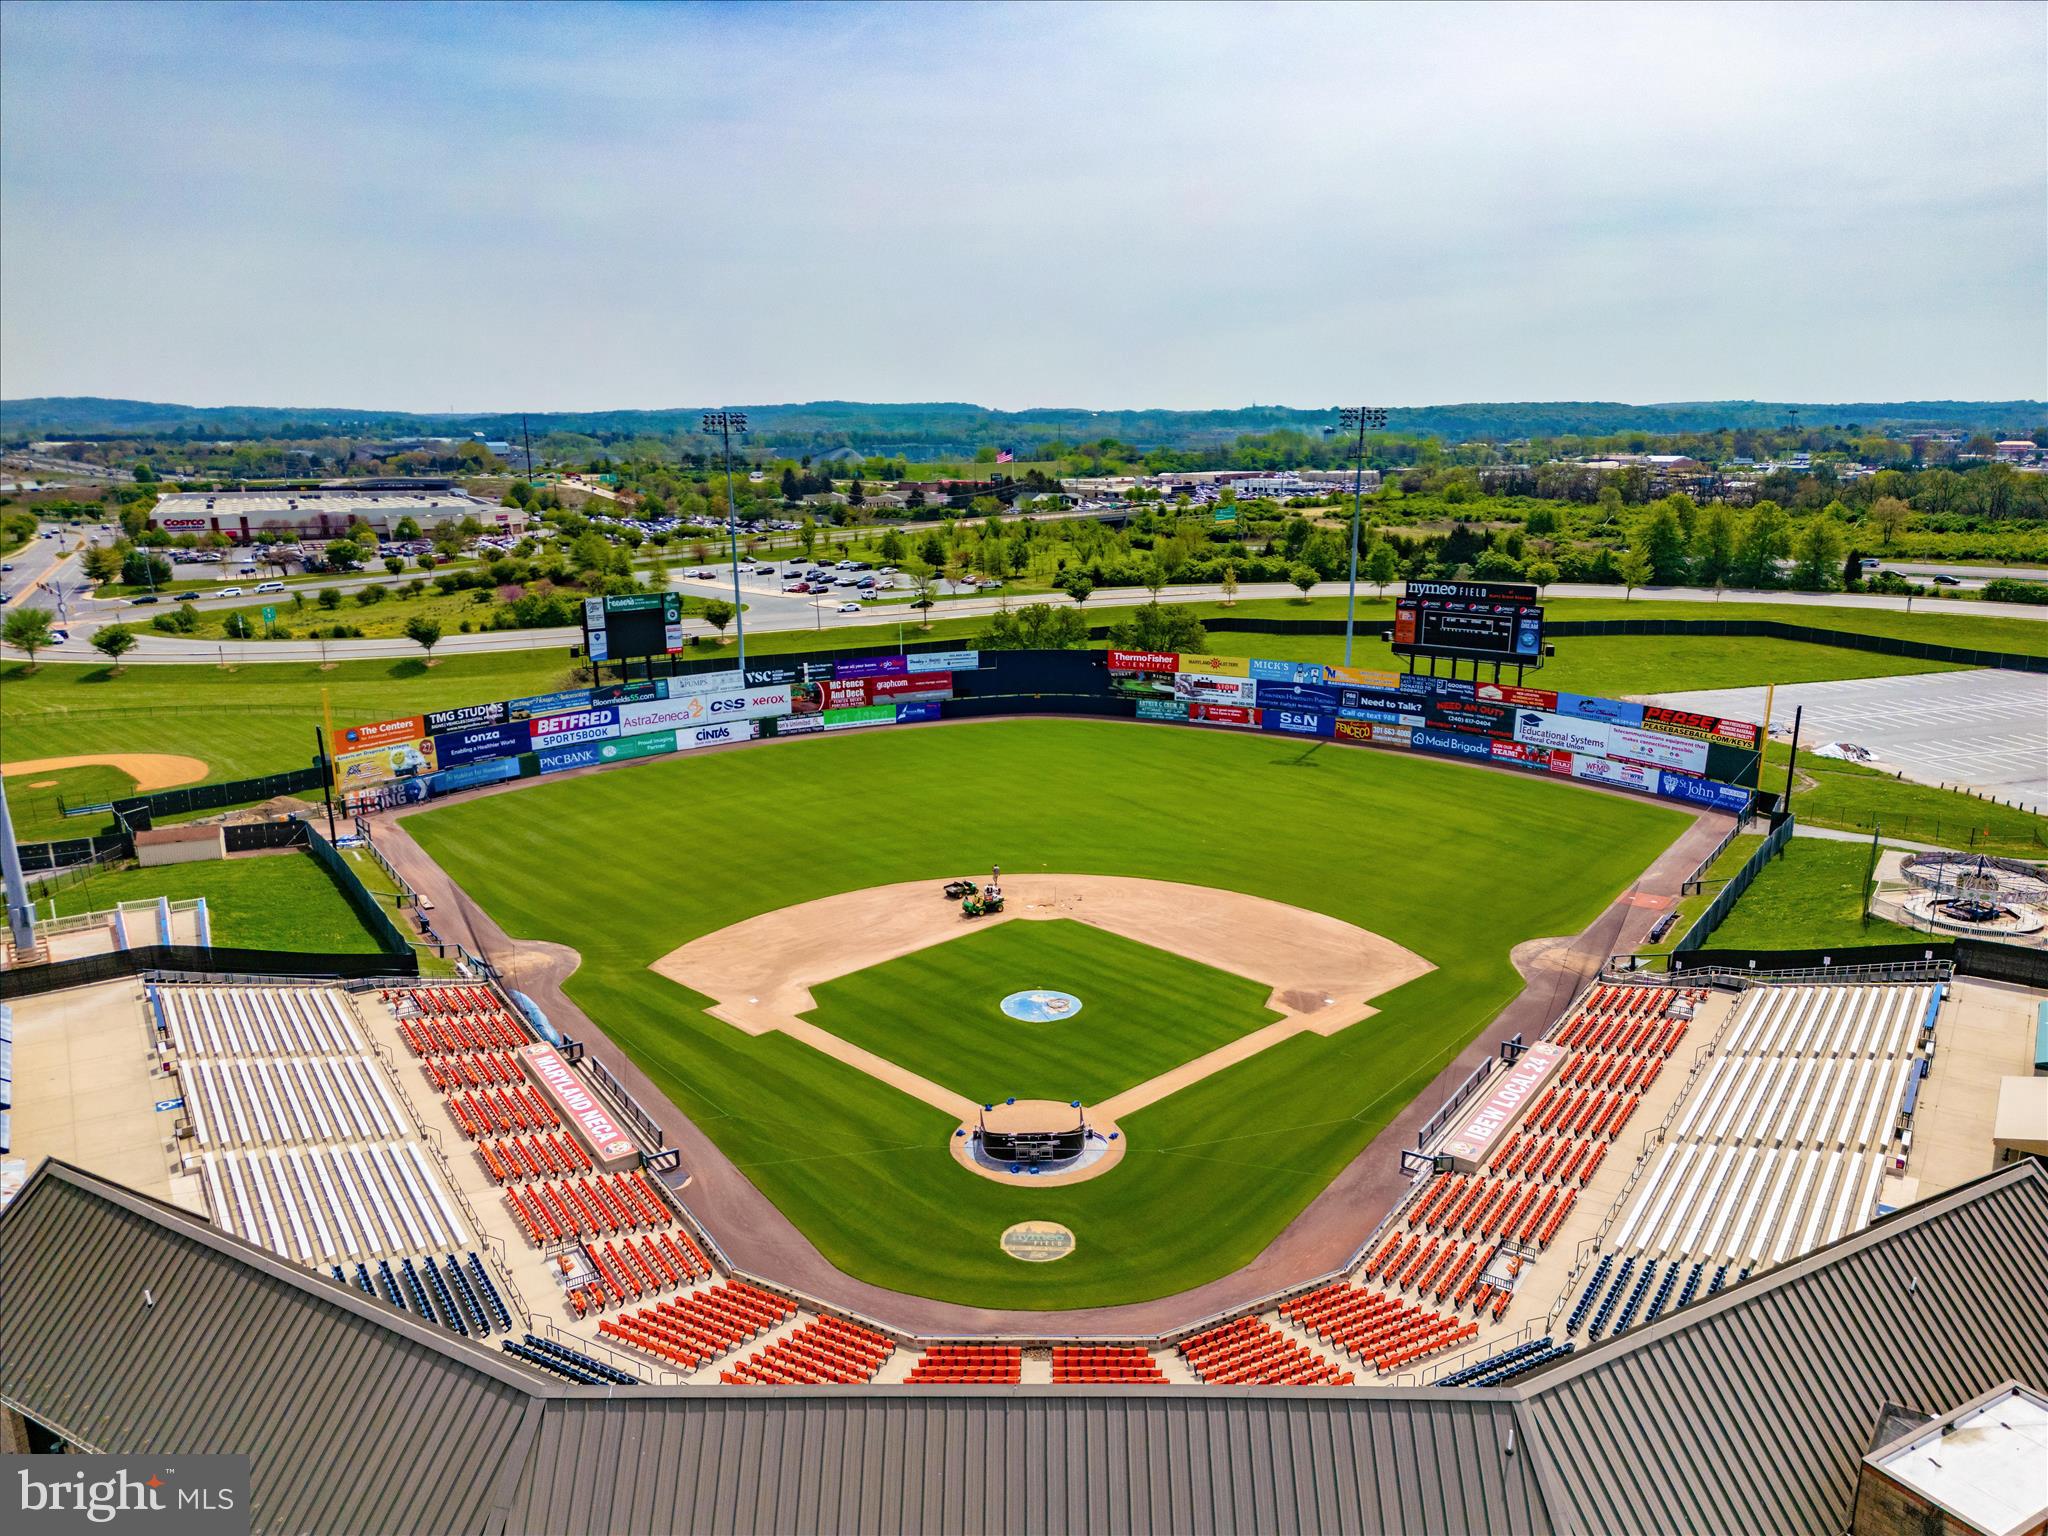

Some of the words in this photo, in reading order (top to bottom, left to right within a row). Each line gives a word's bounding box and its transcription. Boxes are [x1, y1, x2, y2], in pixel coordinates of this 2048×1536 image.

[163, 518, 205, 527] COSTCO
[1408, 582, 1457, 597] nymeo
[1459, 587, 1487, 597] FIELD
[1115, 661, 1172, 669] SCIENTIFIC
[1253, 660, 1289, 671] MICK'S
[829, 680, 841, 689] MC
[842, 680, 864, 688] Fence
[876, 680, 908, 690] graphcom
[1447, 682, 1474, 691] GOODWILL
[592, 693, 654, 707] Bloomfields55.com
[752, 694, 785, 706] xerox
[831, 690, 845, 699] And
[846, 689, 864, 697] Deck
[1360, 697, 1384, 707] Need
[1386, 700, 1396, 708] to
[1397, 702, 1422, 711] Talk?
[1436, 701, 1461, 710] NEED
[1463, 703, 1477, 711] AN
[1479, 706, 1505, 717] OUT?
[429, 711, 455, 724] TMG
[457, 702, 504, 719] STUDIS
[623, 709, 690, 728] AstraZeneca
[1366, 712, 1381, 720] text
[1383, 713, 1396, 721] 988
[1646, 706, 1715, 730] PEASE
[360, 727, 377, 736] The
[379, 720, 414, 732] Centers
[537, 709, 612, 734] BETFRED
[464, 730, 500, 744] Lonza
[543, 727, 608, 746] SPORTSBOOK
[696, 727, 730, 741] CINTAS
[1335, 721, 1370, 739] FENCECO
[1522, 726, 1568, 741] Educational
[1570, 734, 1604, 749] Systems
[1613, 728, 1665, 741] Telecommunications
[1665, 738, 1694, 748] equipment
[1643, 722, 1753, 748] PEASEBASEBALL.COM/KEYS
[450, 745, 473, 756] Enabling
[500, 738, 516, 746] World
[1425, 735, 1450, 748] Maid
[1451, 738, 1487, 754] Brigade
[1521, 734, 1544, 744] Federal
[1545, 737, 1565, 747] Credit
[1566, 742, 1585, 751] Union
[1492, 747, 1518, 758] TEAM!
[359, 785, 390, 800] Place
[391, 784, 405, 793] to
[1686, 781, 1714, 798] John
[535, 1055, 593, 1111] MARYLAND
[578, 1109, 618, 1144] NECA
[1464, 1106, 1504, 1141] IBEW
[1492, 1073, 1538, 1109] LOCAL
[1523, 1057, 1550, 1073] 24
